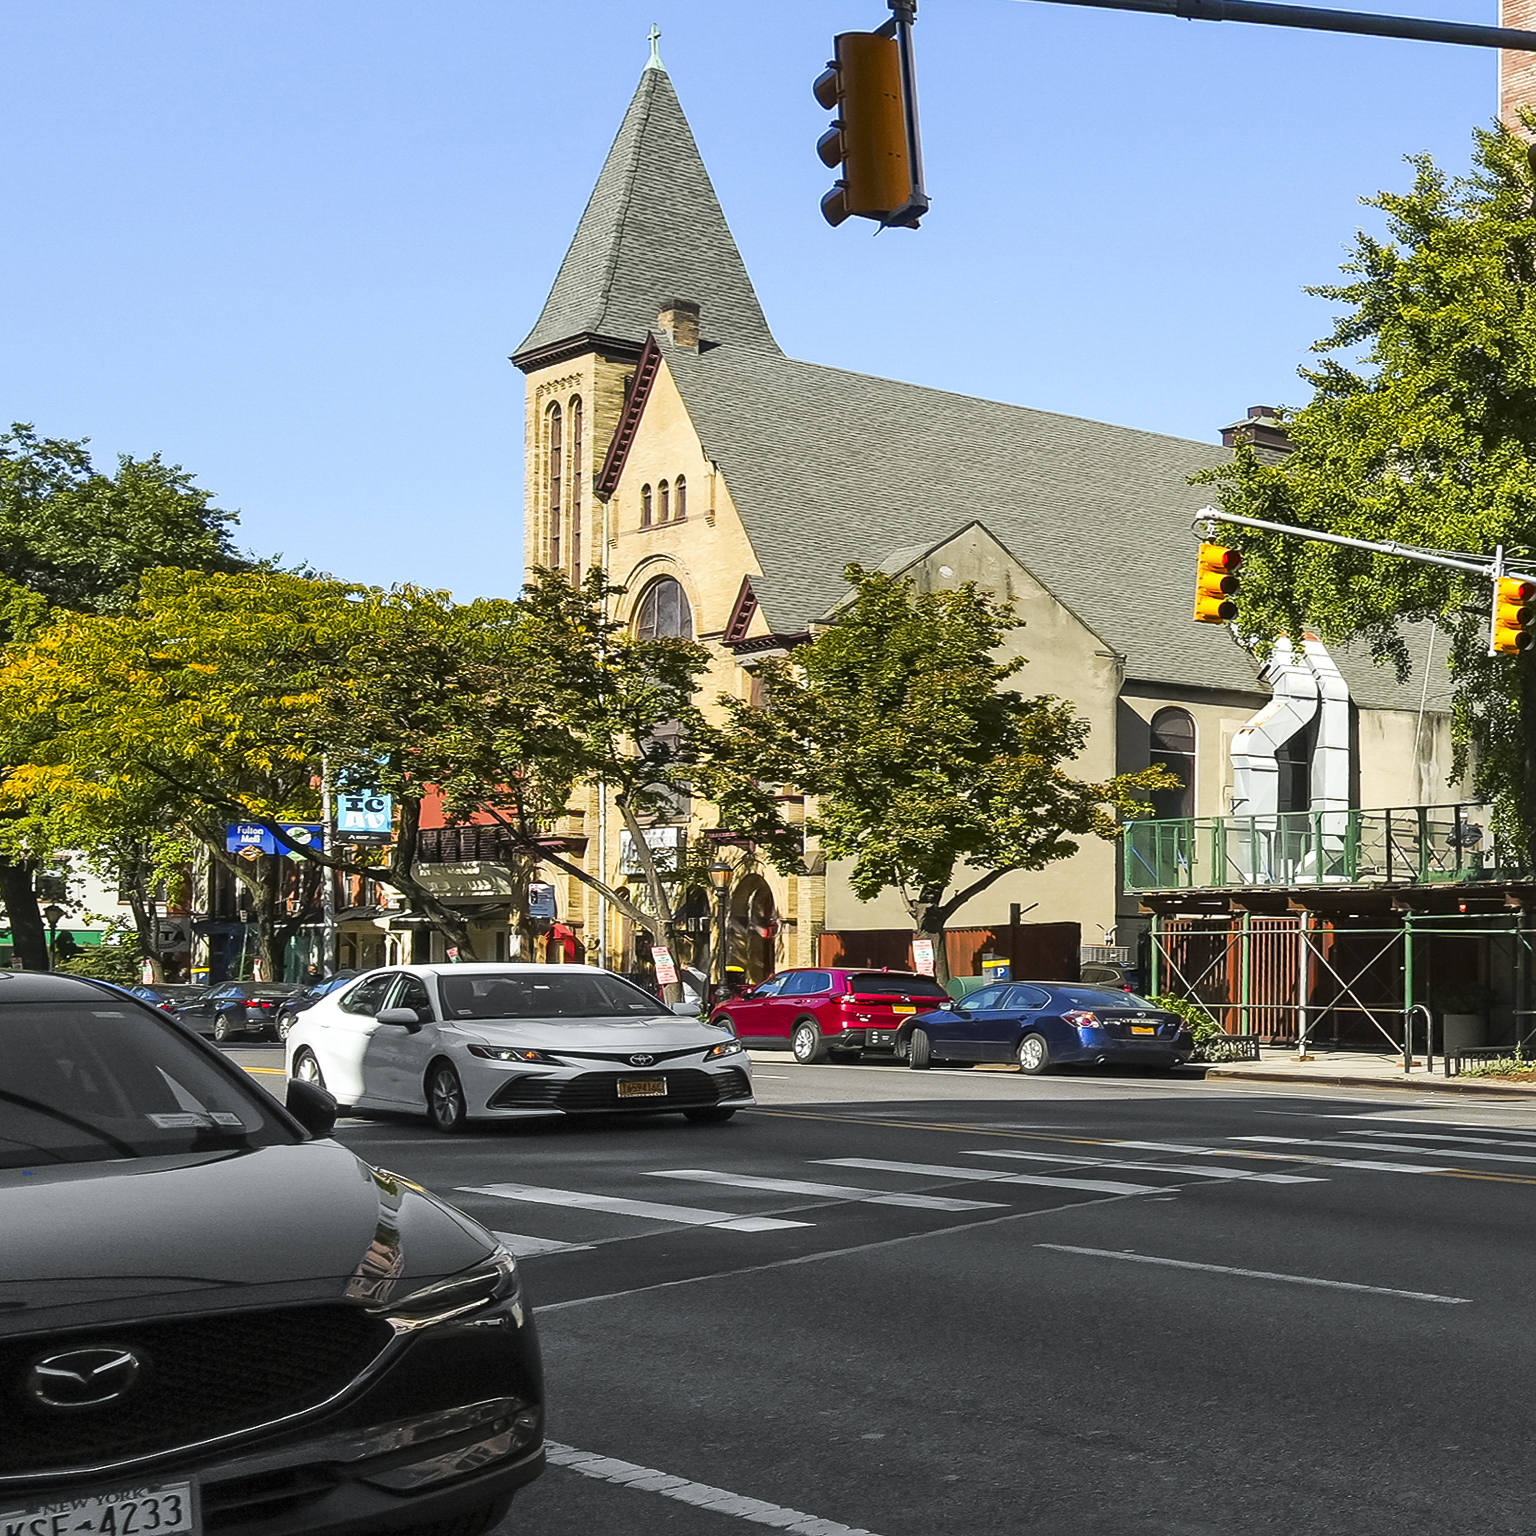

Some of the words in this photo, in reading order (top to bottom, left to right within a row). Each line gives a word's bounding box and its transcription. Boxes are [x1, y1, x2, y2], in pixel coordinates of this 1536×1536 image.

[42, 1498, 87, 1516] NEW
[96, 1487, 149, 1507] YORK
[99, 1494, 183, 1536] 4233
